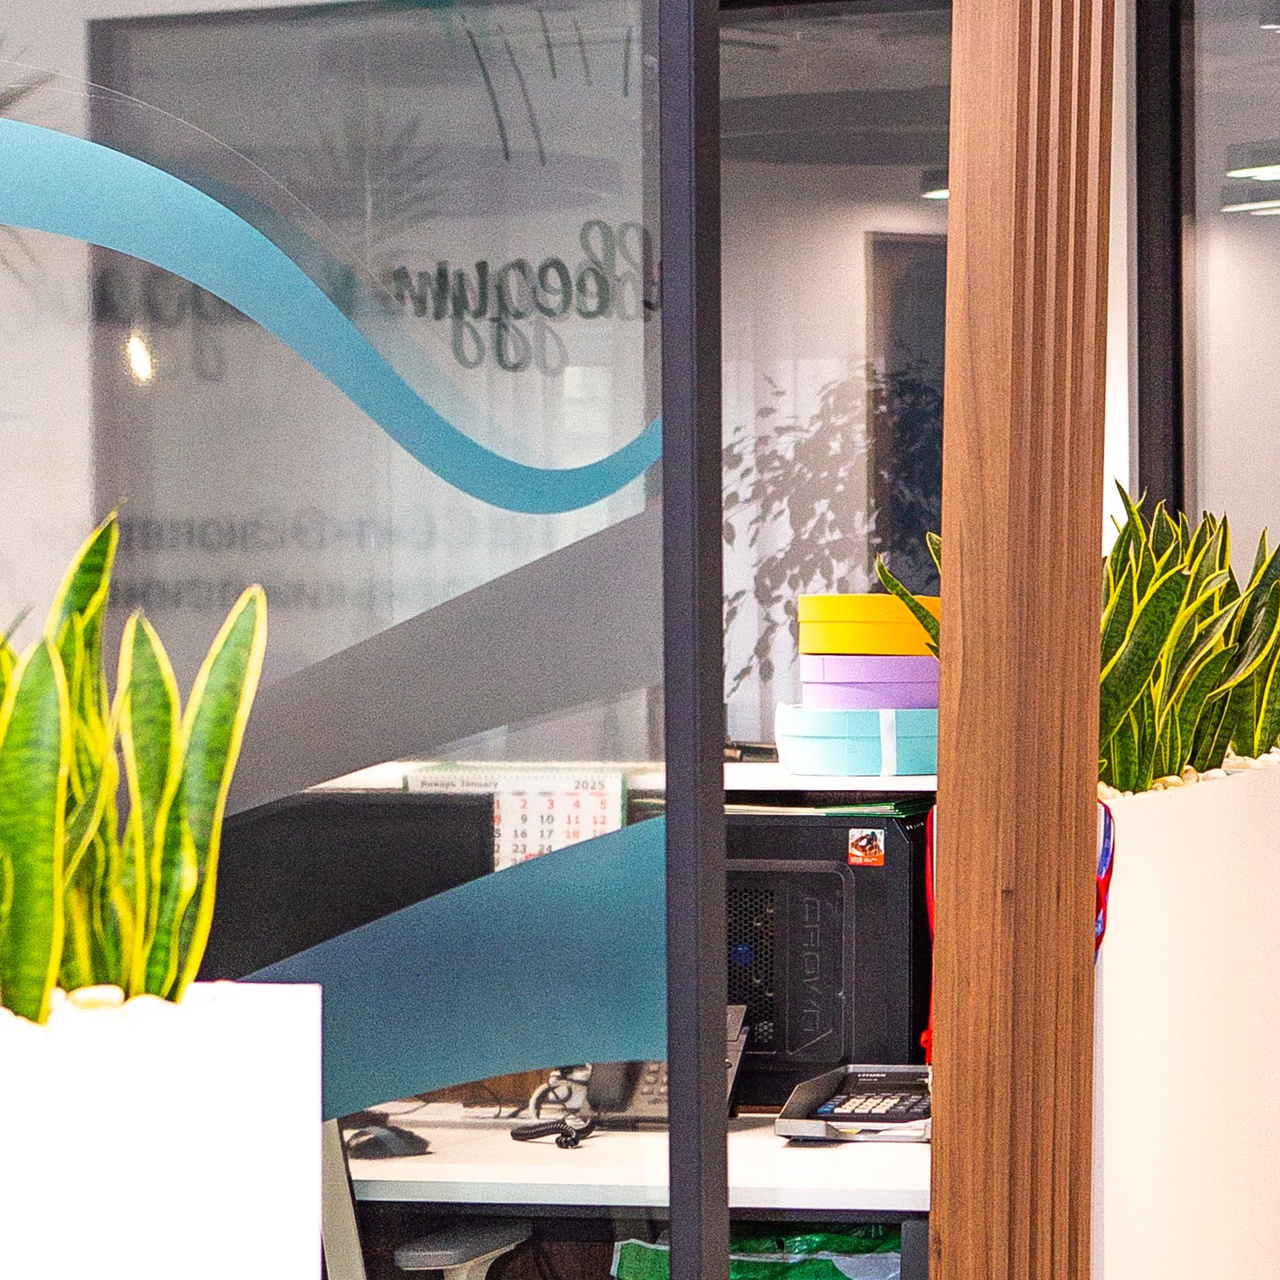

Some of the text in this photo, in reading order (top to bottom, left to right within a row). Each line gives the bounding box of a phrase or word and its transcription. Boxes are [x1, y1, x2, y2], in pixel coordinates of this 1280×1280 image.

[461, 780, 498, 789] January
[574, 780, 605, 790] 2025
[520, 799, 528, 809] 2
[547, 799, 555, 810] 3
[572, 800, 580, 809] 4
[600, 799, 607, 810] 5
[520, 814, 528, 824] 9
[540, 814, 554, 824] 10
[566, 815, 581, 825] 11
[593, 815, 606, 825] 12
[513, 829, 528, 839] 16
[540, 829, 554, 839] 17
[566, 829, 580, 839] 18
[512, 843, 527, 854] 23
[539, 843, 553, 854] 24
